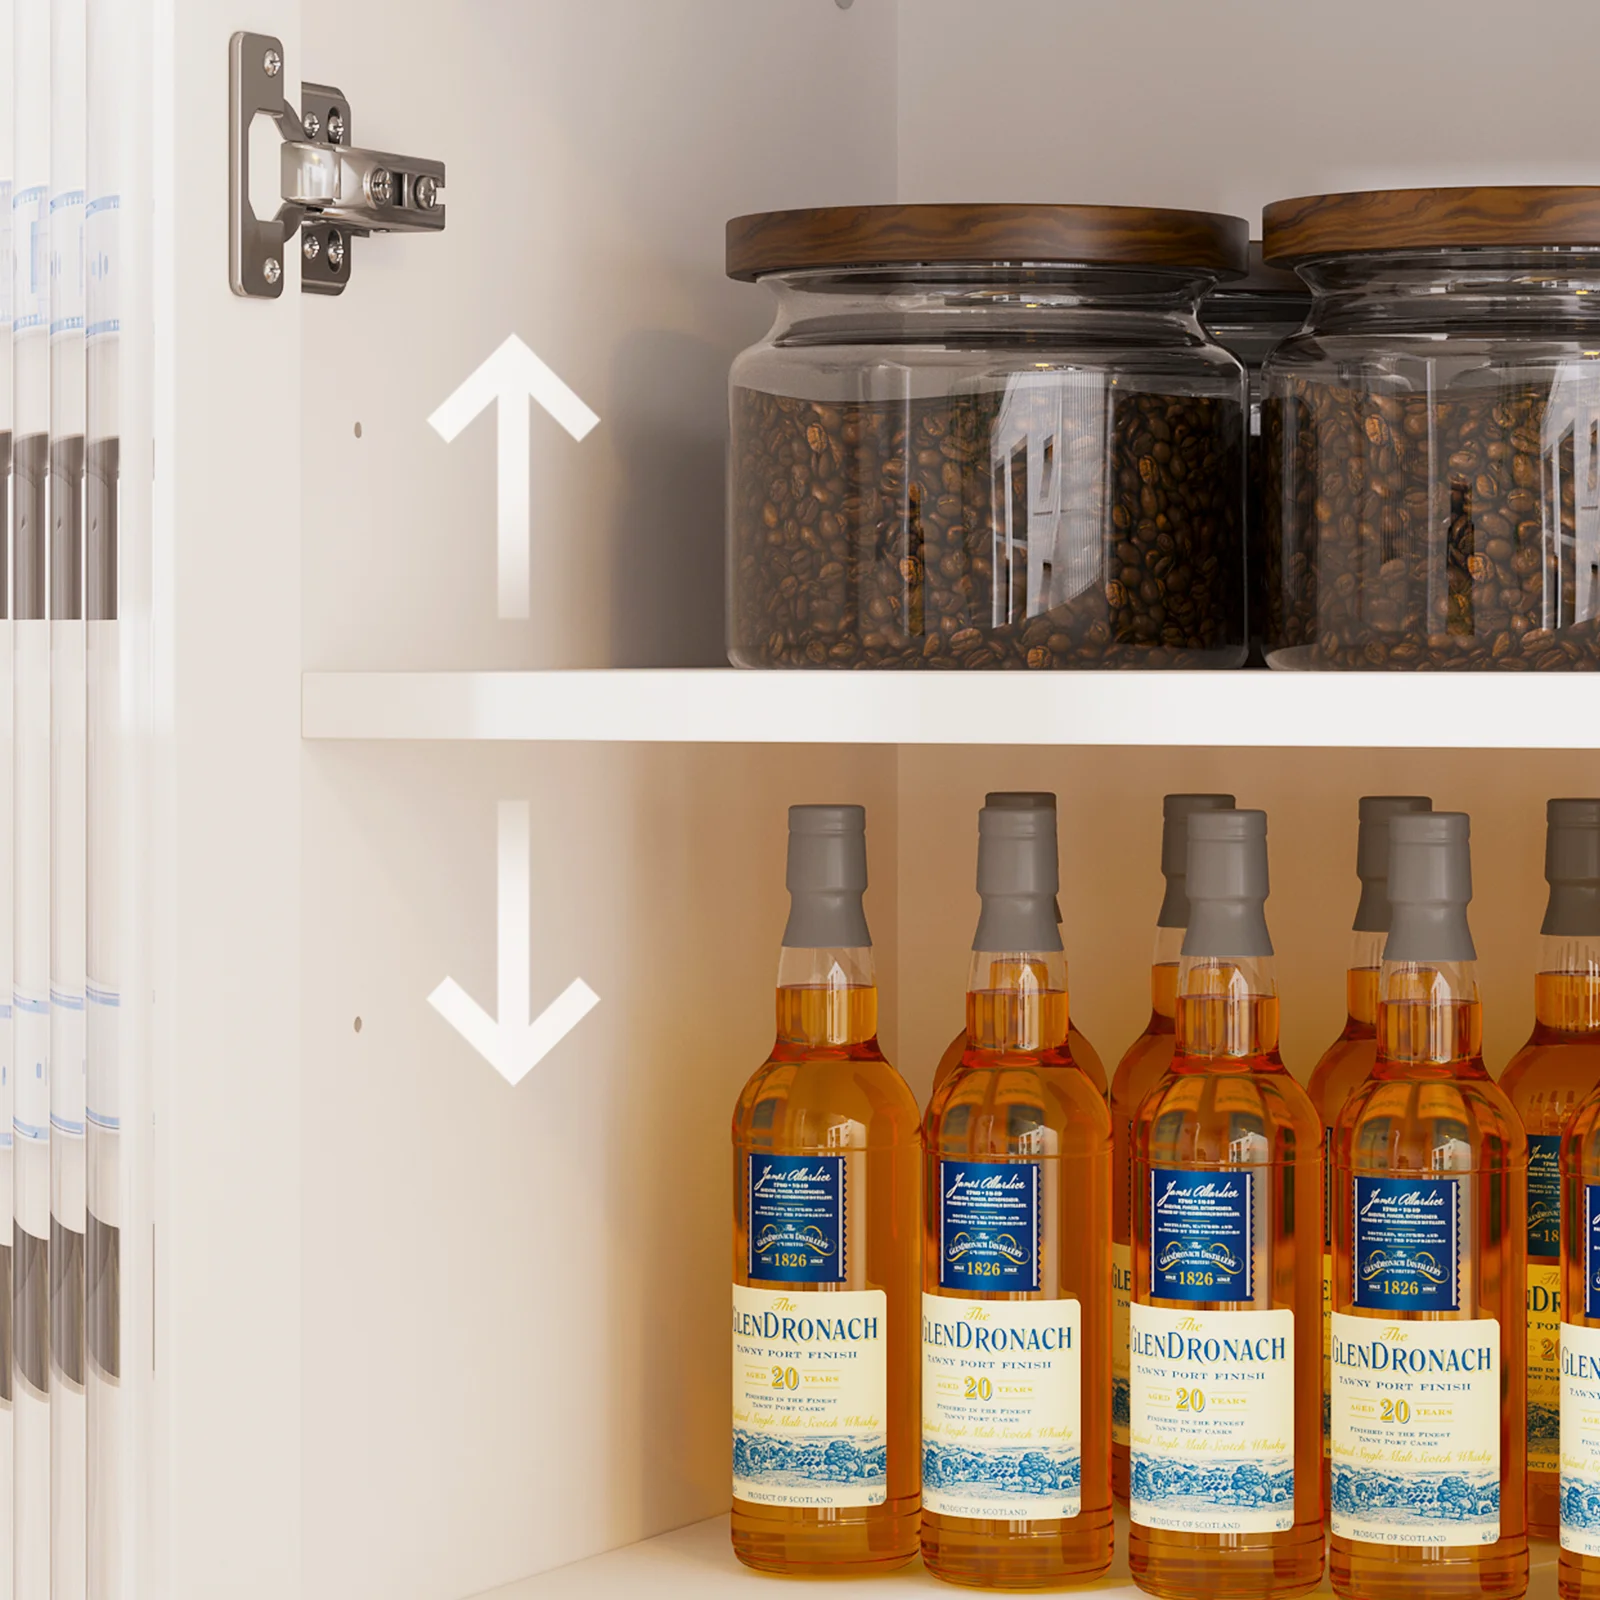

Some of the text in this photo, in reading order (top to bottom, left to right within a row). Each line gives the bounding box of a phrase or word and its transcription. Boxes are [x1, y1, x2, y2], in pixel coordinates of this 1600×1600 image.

[754, 1165, 787, 1190] James
[946, 1172, 980, 1198] James
[1157, 1180, 1192, 1206] James
[1360, 1189, 1398, 1215] James
[775, 1253, 807, 1266] 1826
[968, 1262, 1000, 1275] 1826
[1179, 1271, 1213, 1285] 1826
[1384, 1281, 1418, 1295] 1826
[770, 1297, 797, 1312] The
[964, 1307, 991, 1321] The
[1176, 1317, 1203, 1331] The
[1380, 1326, 1408, 1342] The
[737, 1344, 857, 1359] TAWNY PORT FINISH
[927, 1355, 956, 1367] TAWNY
[961, 1361, 995, 1369] PORT
[746, 1372, 766, 1380] AGED
[771, 1366, 798, 1390] 20
[1137, 1365, 1264, 1380] TAWNY PORT FINISH
[937, 1382, 959, 1390] AGED
[964, 1376, 992, 1400] 20
[1339, 1376, 1471, 1391] TAWNY PORT FINISH
[745, 1392, 774, 1402] FINISHED
[1147, 1393, 1170, 1401] AGED
[1176, 1387, 1205, 1412] 20
[937, 1403, 967, 1412] FINISHED
[1350, 1404, 1374, 1413] AGED
[1380, 1398, 1410, 1423] 20
[751, 1412, 774, 1428] Single
[777, 1416, 801, 1428] Malt
[803, 1415, 838, 1427] Scotch
[843, 1415, 879, 1429] Whisky
[1147, 1415, 1178, 1424] FINISHED
[942, 1423, 968, 1439] Single
[971, 1426, 995, 1438] Malt
[997, 1427, 1031, 1438] Scotch
[1037, 1427, 1071, 1440] Whisky
[1350, 1426, 1382, 1436] FINISHED
[1153, 1435, 1179, 1451] Single
[1183, 1438, 1207, 1450] Malt
[1209, 1439, 1245, 1450] Scotch
[1250, 1439, 1285, 1452] Whisky
[1356, 1447, 1384, 1463] Single
[1387, 1450, 1412, 1462] Malt
[1415, 1451, 1451, 1462] Scotch
[1456, 1451, 1492, 1464] Whisky
[748, 1492, 776, 1502] PRODUCT
[789, 1496, 833, 1504] SCOTLAND
[939, 1502, 969, 1513] PRODUCT
[983, 1508, 1027, 1516] SCOTLAND
[1150, 1516, 1180, 1527] PRODUCT
[1195, 1521, 1240, 1529] SCOTLAND
[1353, 1529, 1385, 1541] PRODUCT
[1400, 1534, 1446, 1543] SCOTLAND
